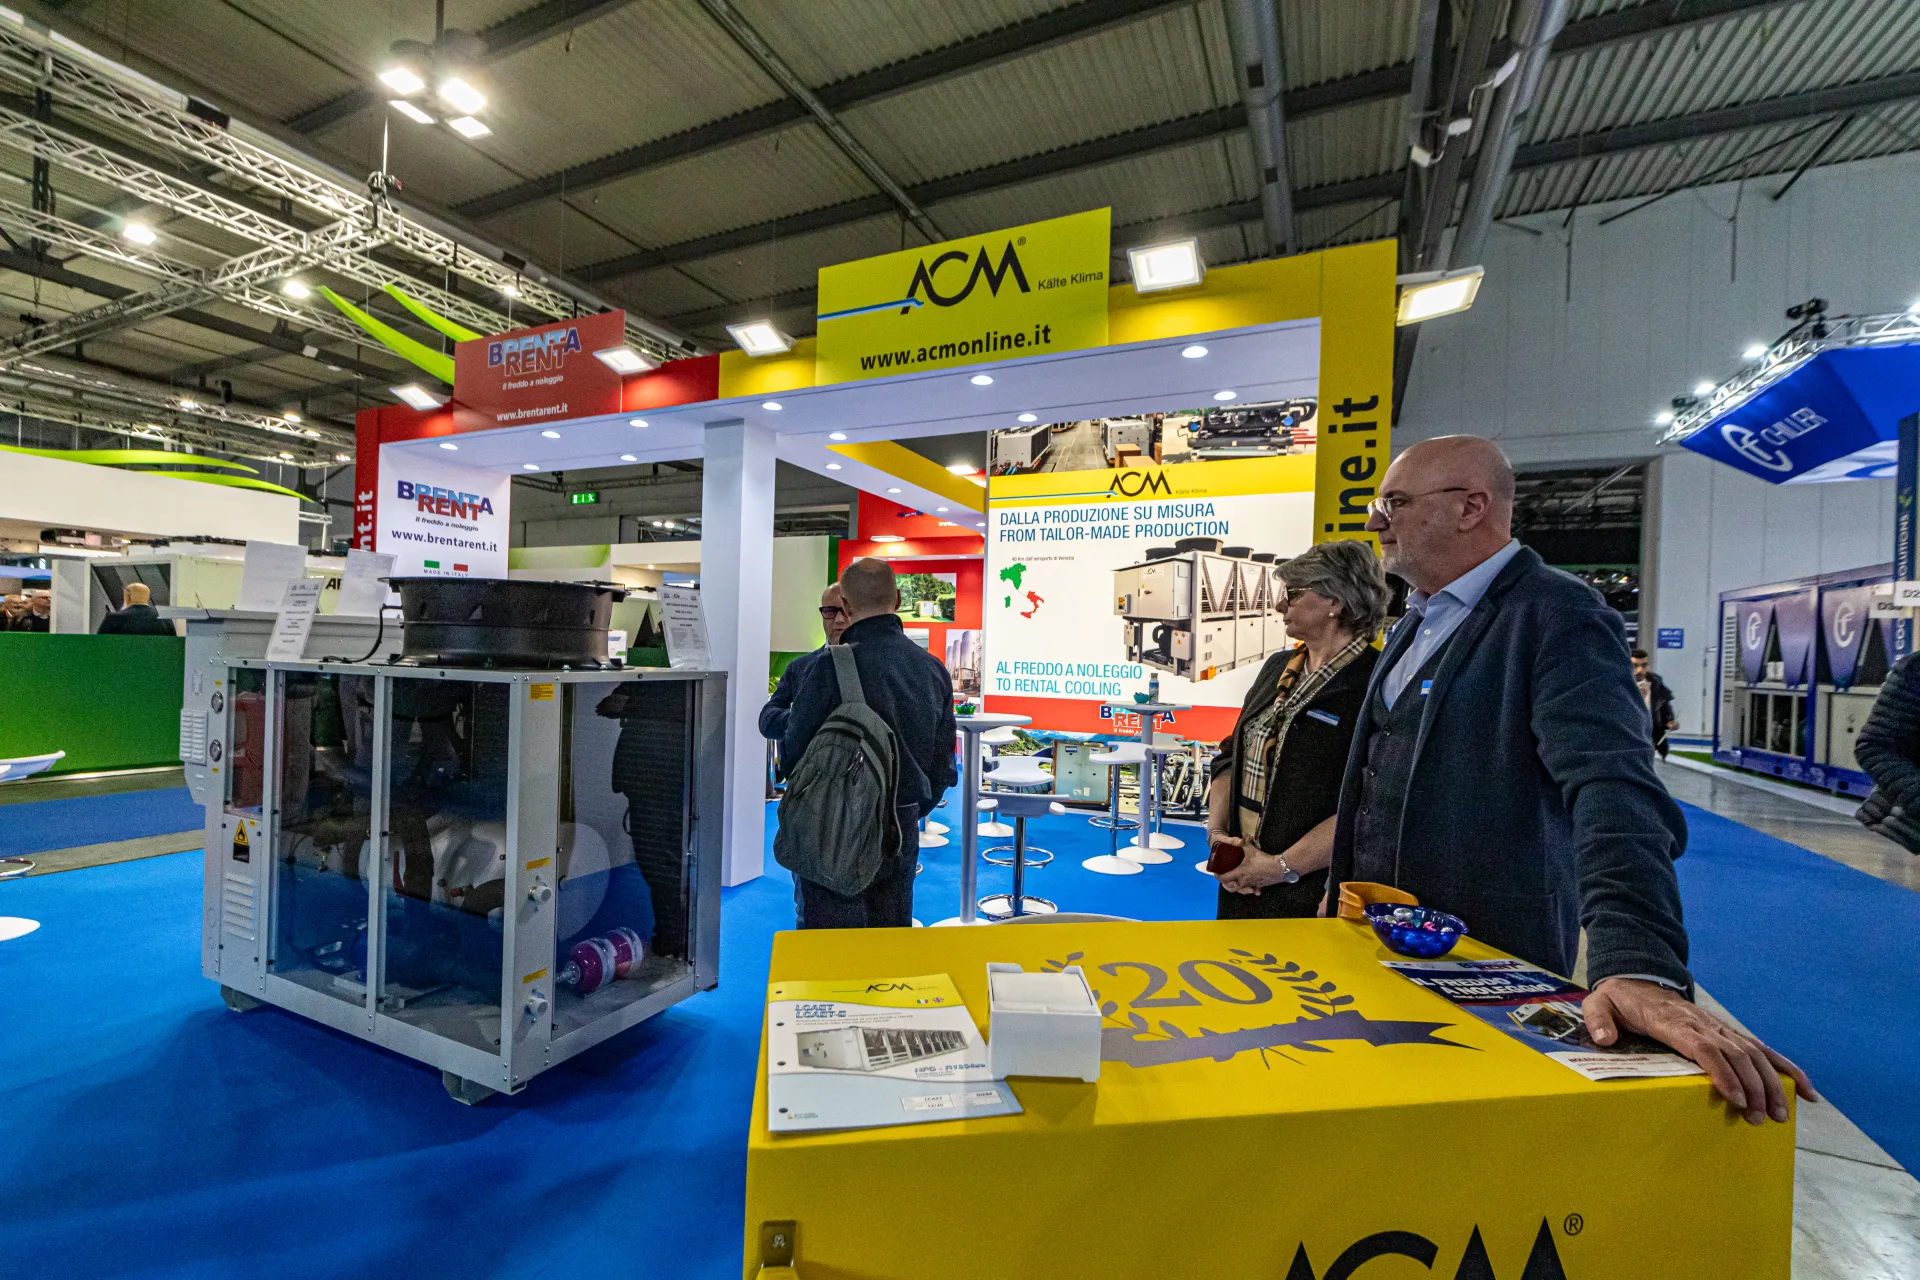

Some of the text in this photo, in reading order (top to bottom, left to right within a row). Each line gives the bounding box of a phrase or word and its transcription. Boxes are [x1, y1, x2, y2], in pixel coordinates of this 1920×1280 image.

[1037, 274, 1067, 291] Kälte
[1069, 270, 1104, 285] Klima
[860, 324, 1052, 370] www.acmonline.it
[504, 344, 565, 377] RENT
[535, 374, 564, 386] noleggio
[497, 402, 568, 422] www.brentarent.it
[418, 494, 482, 521] RENT
[1000, 502, 1215, 526] DALLA PRODUZIONE SU MISURA
[421, 517, 444, 527] freddo
[451, 522, 479, 532] noleggio
[1000, 521, 1229, 543] FROM TAILOR-MADE PRODUCTION
[391, 530, 498, 552] www.brentarent.it
[996, 661, 1143, 679] AL FREDDO A NOLEGGIO
[996, 677, 1122, 696] TO RENTAL COOLING
[1431, 977, 1512, 987] FREDDO
[1455, 984, 1557, 995] NOLEGGIO
